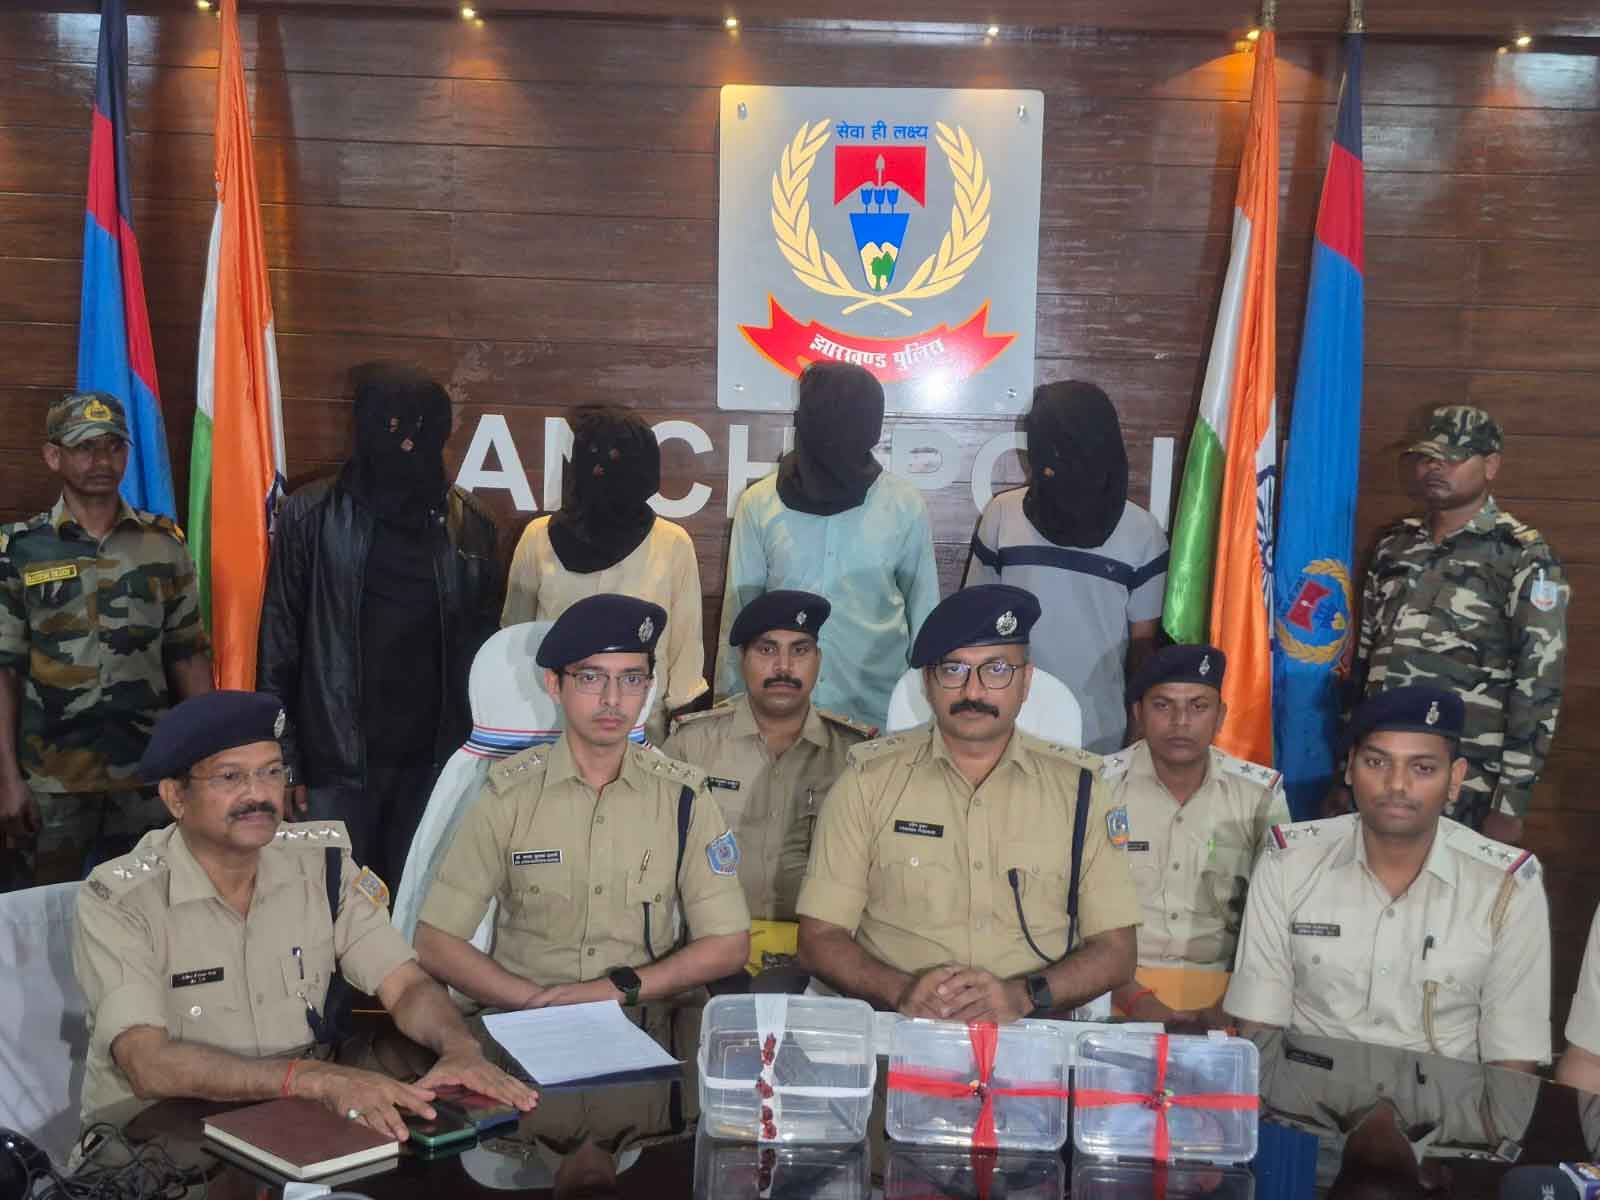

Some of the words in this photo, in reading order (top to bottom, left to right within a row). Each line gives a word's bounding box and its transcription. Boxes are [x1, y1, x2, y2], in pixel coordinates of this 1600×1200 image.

[836, 120, 865, 138] सेवा
[871, 120, 888, 140] ही
[893, 124, 929, 140] लक्ष्य
[809, 334, 887, 368] झारखण्ड
